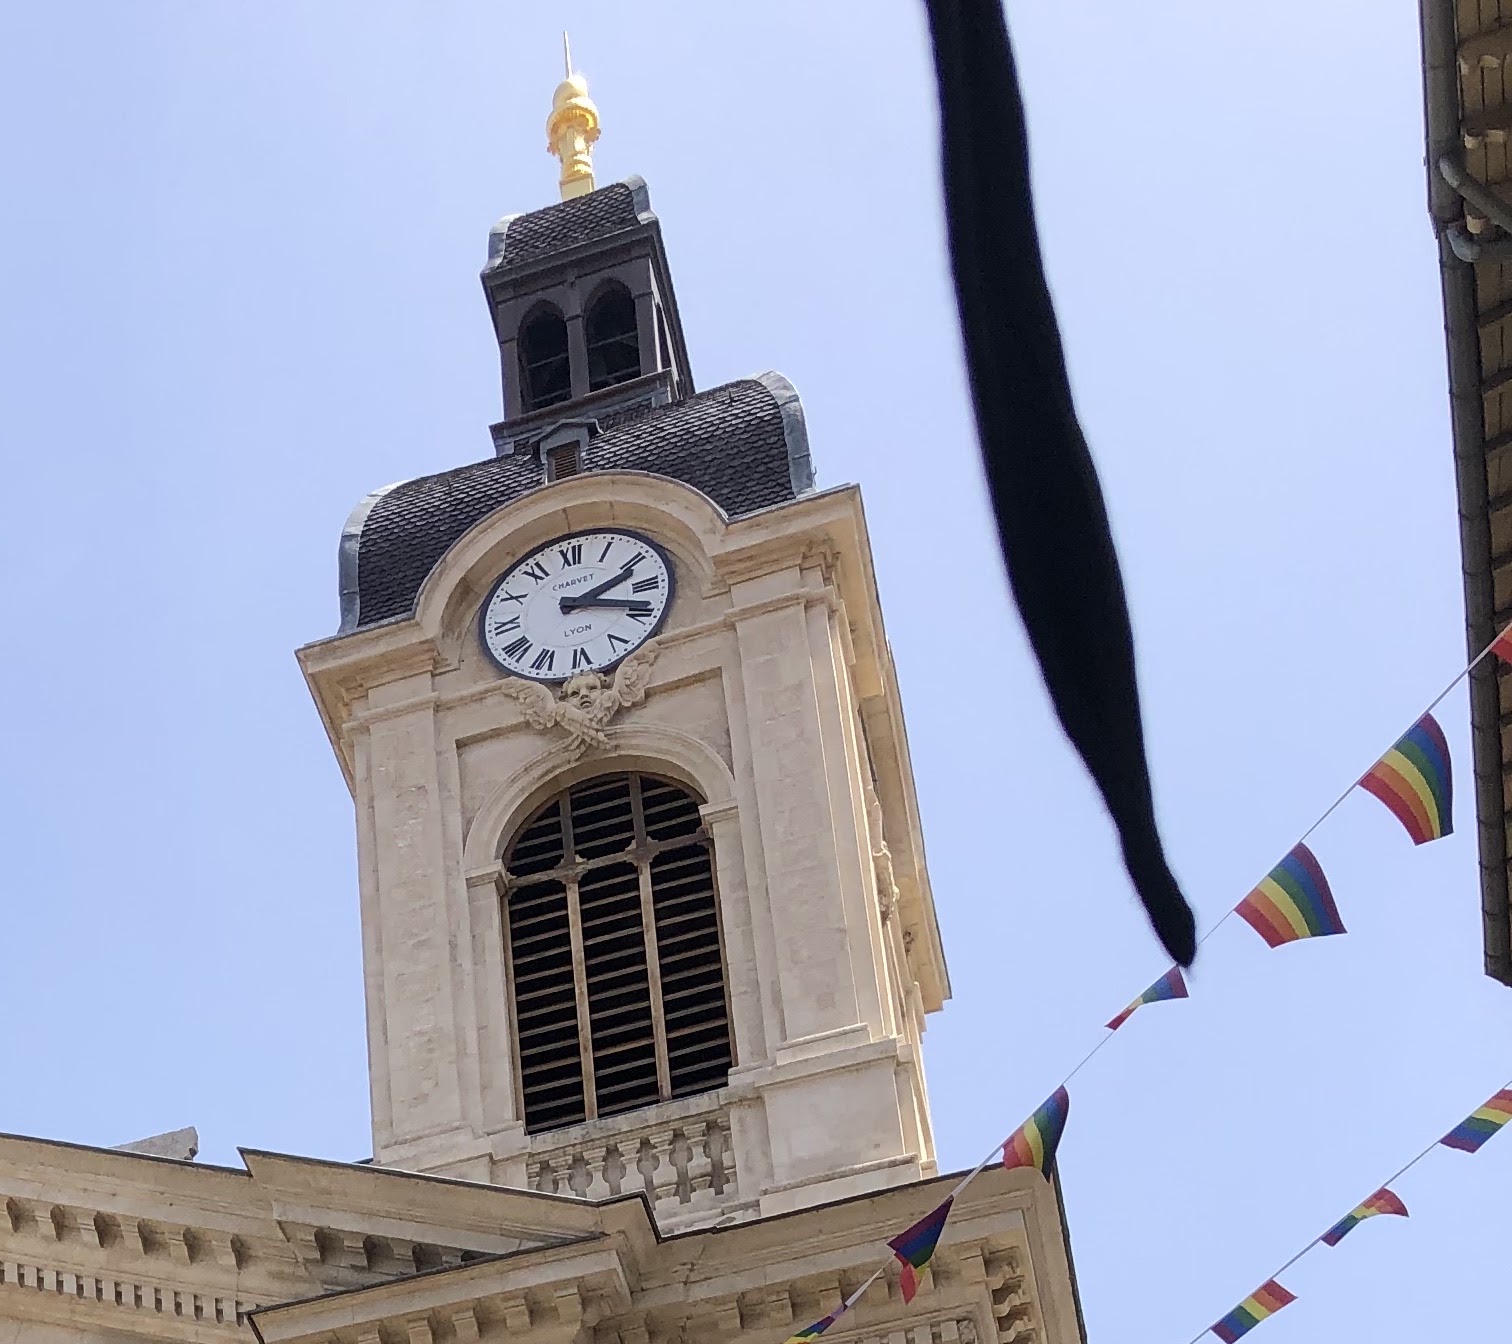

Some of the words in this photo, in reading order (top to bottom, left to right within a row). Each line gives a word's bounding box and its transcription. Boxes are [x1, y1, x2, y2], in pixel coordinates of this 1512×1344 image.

[559, 544, 583, 570] XII
[522, 561, 551, 585] XI
[552, 573, 595, 592] CHARVET
[564, 623, 592, 638] LYON
